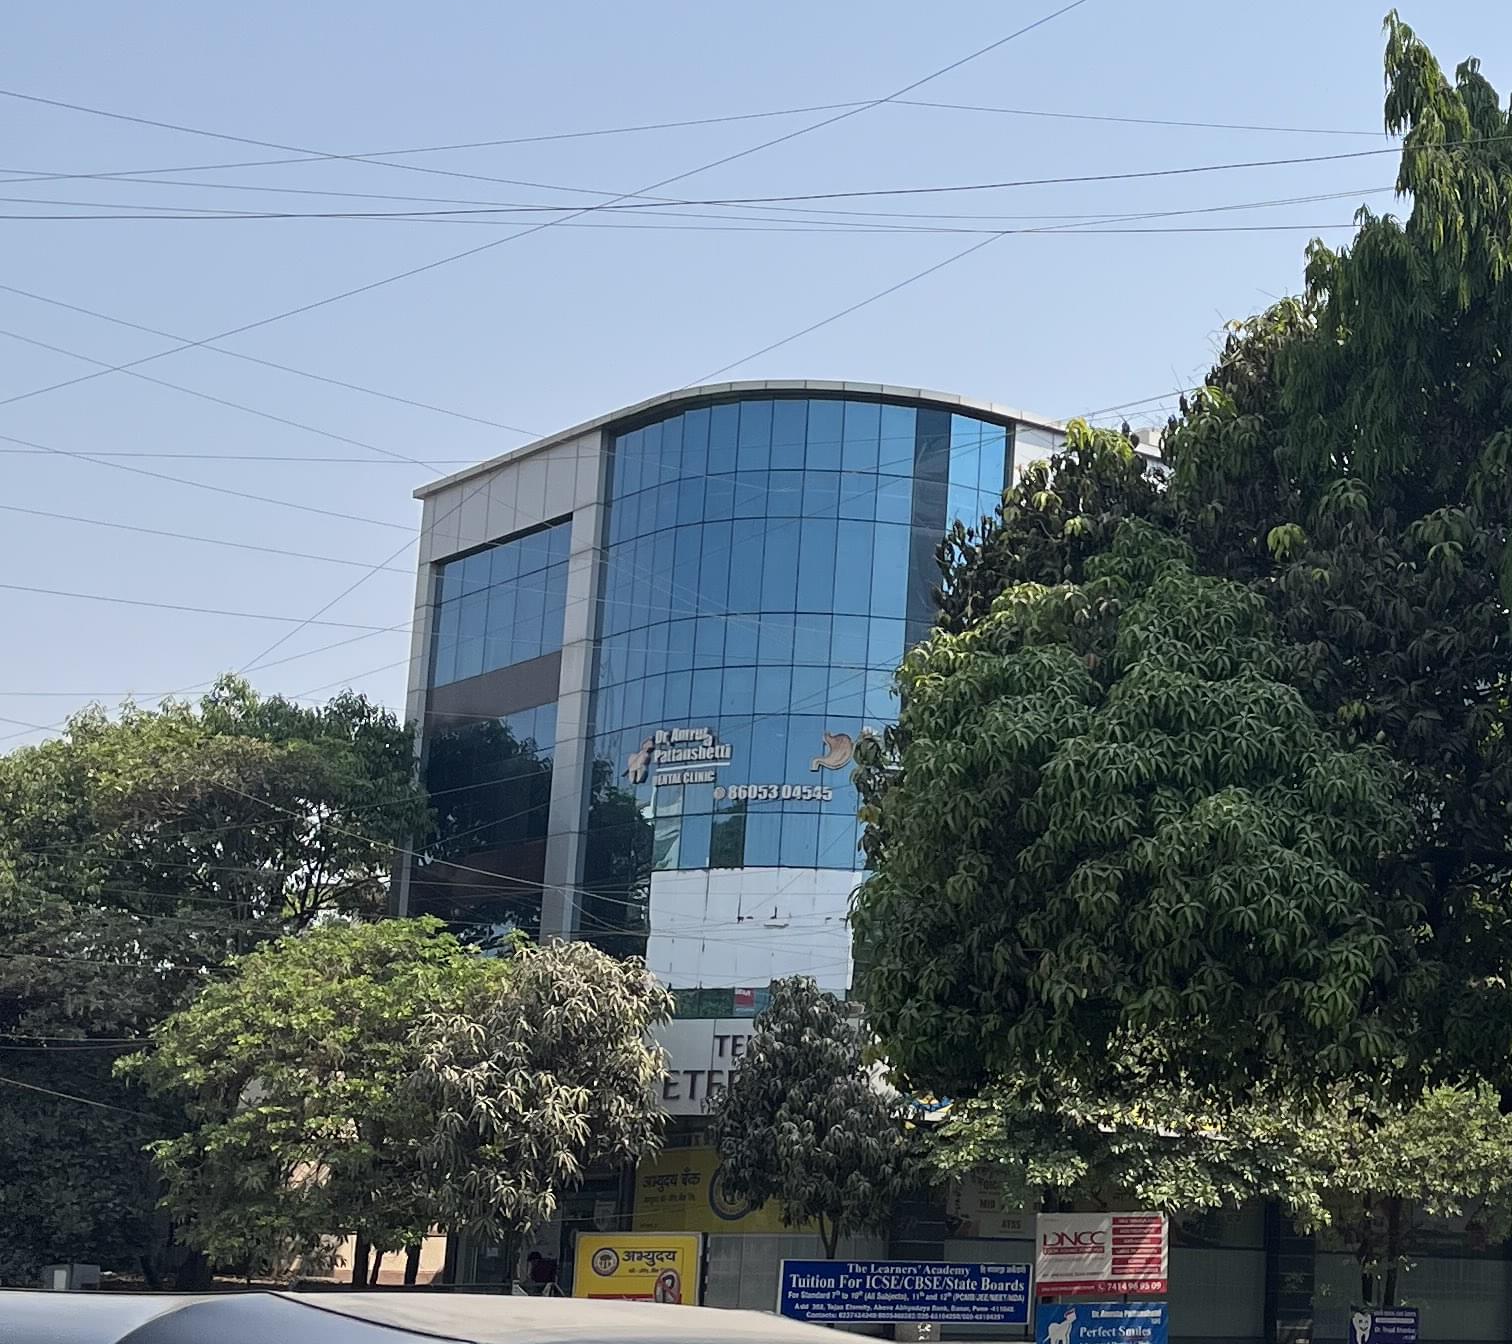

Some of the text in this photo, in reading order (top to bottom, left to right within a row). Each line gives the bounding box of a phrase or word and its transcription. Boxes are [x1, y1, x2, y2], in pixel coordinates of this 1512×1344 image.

[654, 743, 731, 763] Pattanshetti
[728, 784, 832, 801] 86053 04545
[1043, 1231, 1107, 1246] DNCC
[621, 1249, 678, 1266] अभ्युदय
[848, 1263, 867, 1273] The
[870, 1263, 921, 1274] Learners'
[923, 1264, 971, 1277] Academy
[790, 1274, 835, 1288] Tuition
[840, 1275, 862, 1288] For
[866, 1275, 978, 1290] ICSE/CBSE/State
[981, 1277, 1025, 1291] Boards
[788, 1291, 799, 1299] For
[801, 1291, 830, 1299] Standard
[926, 1292, 938, 1301] and
[1080, 1326, 1152, 1337] Perfect Smiles
